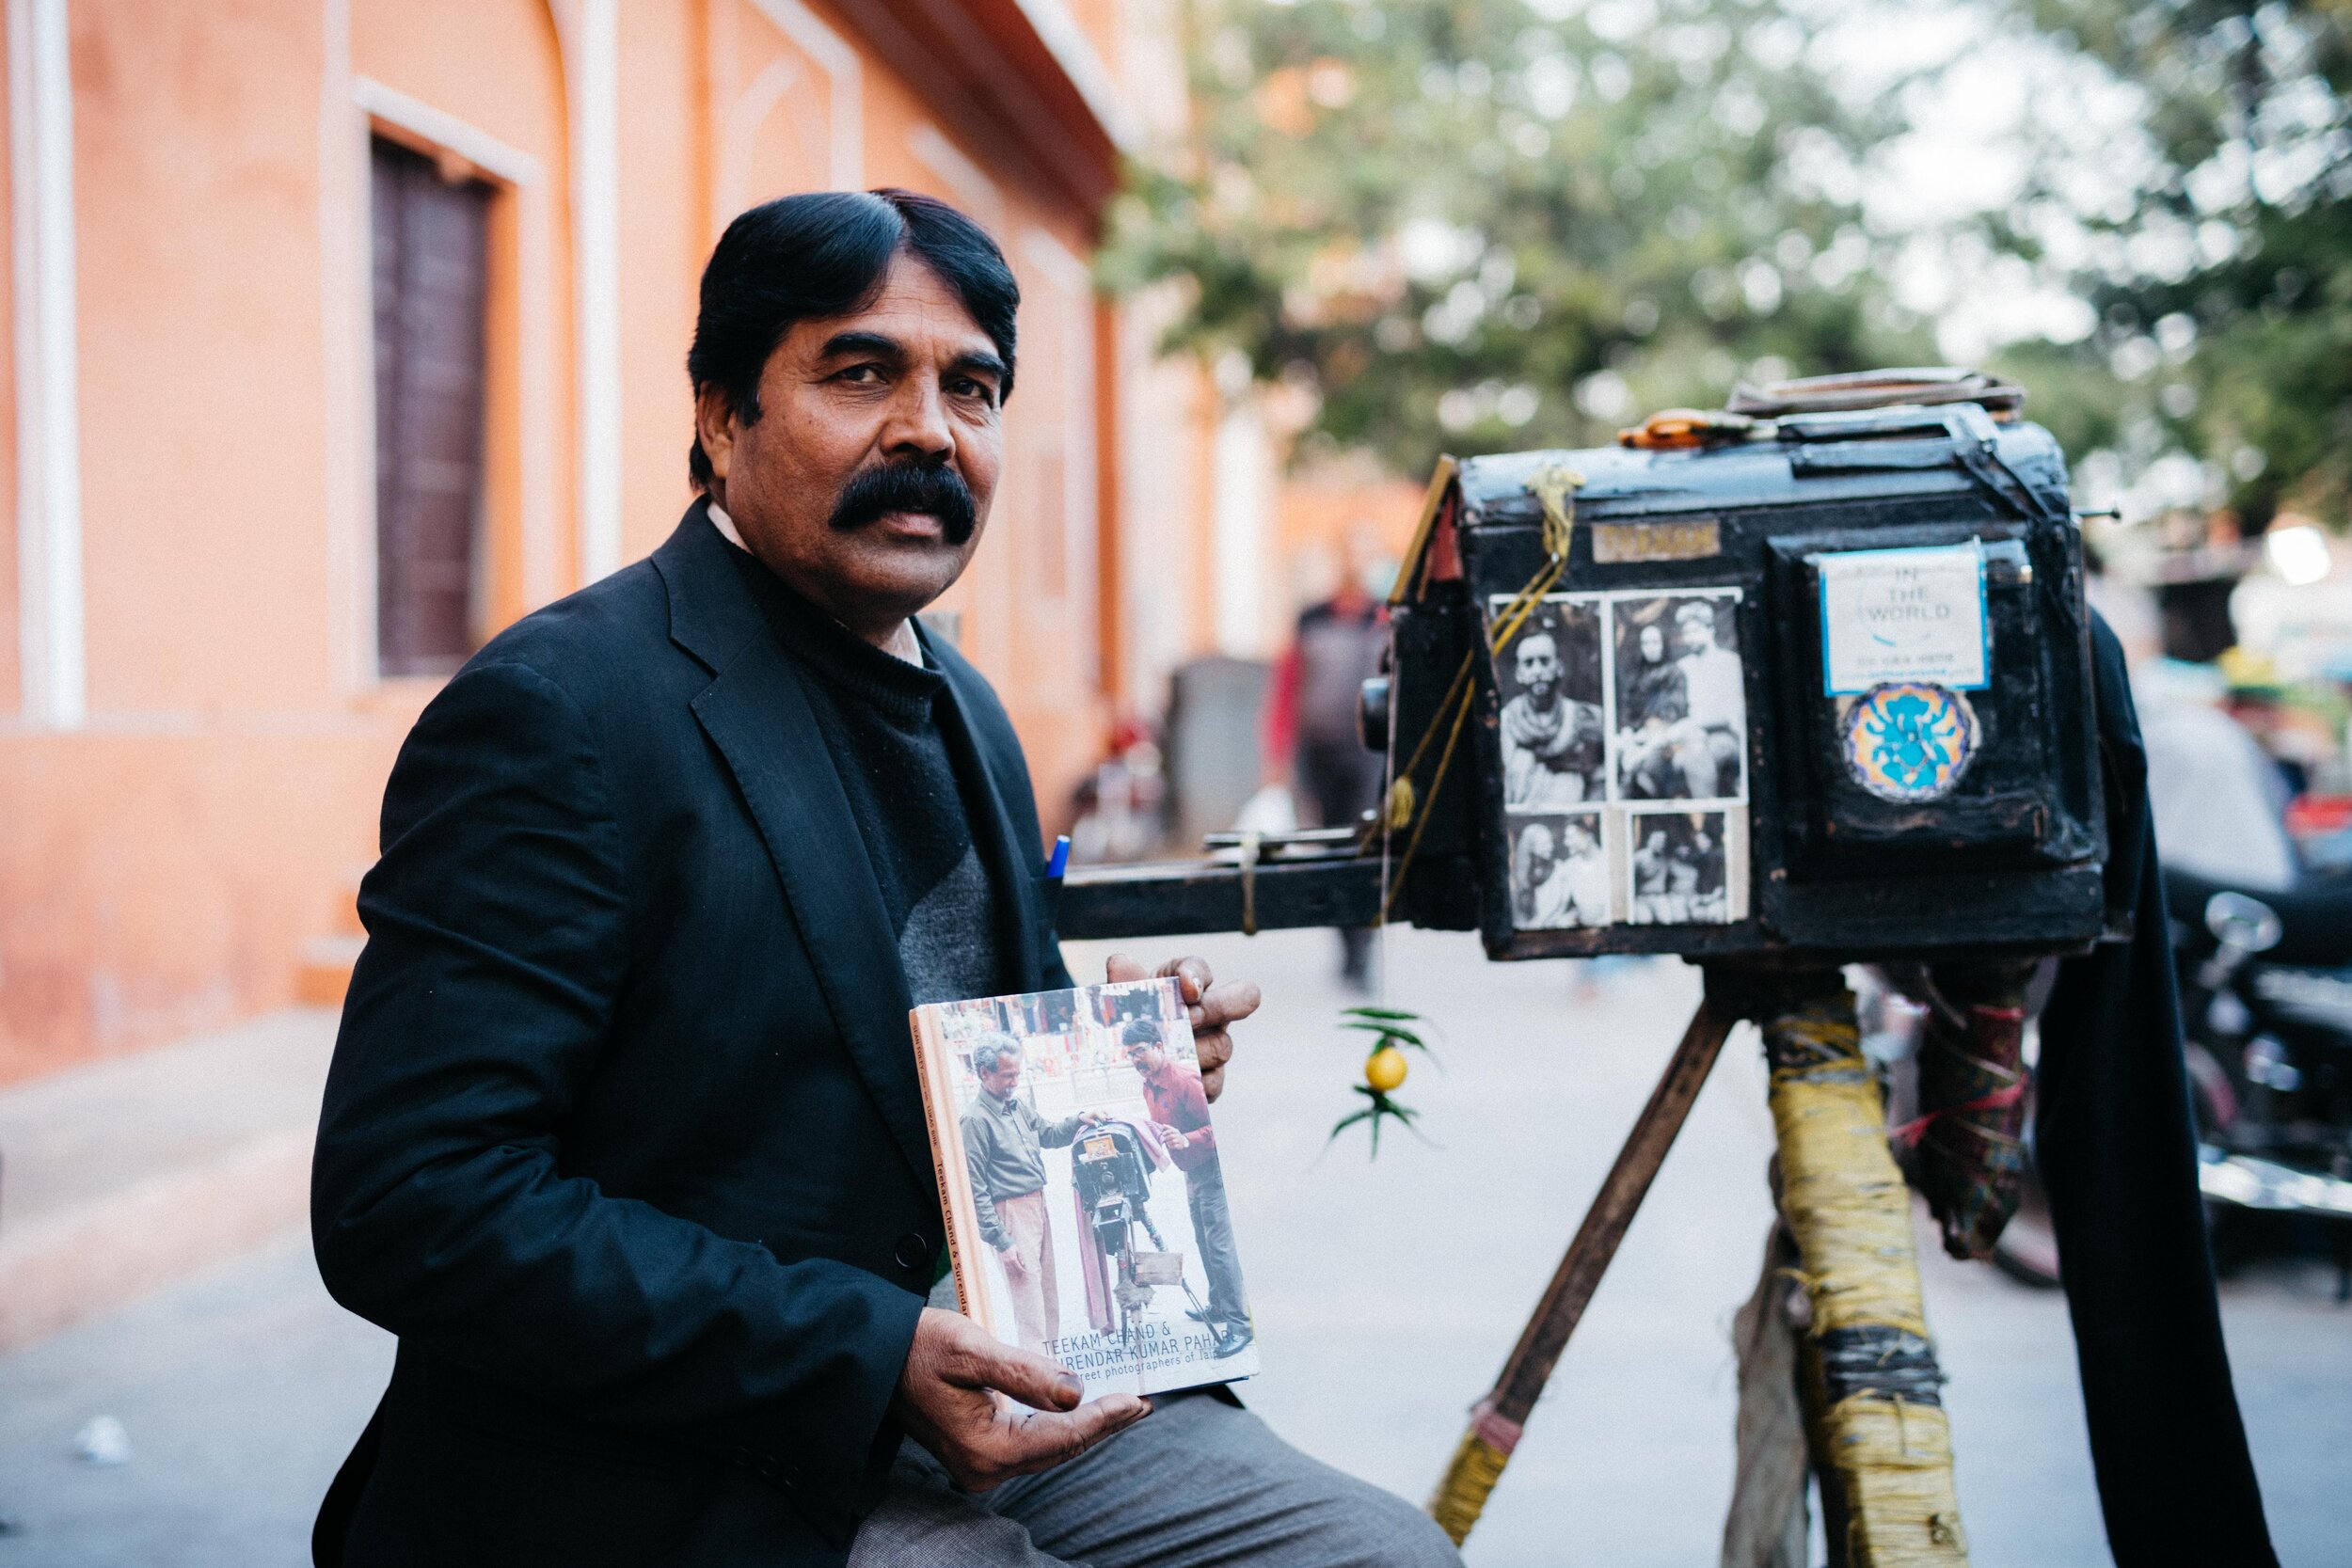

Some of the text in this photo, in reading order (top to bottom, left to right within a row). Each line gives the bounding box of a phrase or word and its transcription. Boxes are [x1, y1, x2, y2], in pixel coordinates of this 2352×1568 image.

[1887, 586, 1928, 602] THE
[1867, 603, 1951, 621] WORLD
[937, 1163, 948, 1205] Teekam
[945, 1210, 957, 1245] Chand
[954, 1263, 967, 1316] Surendar
[1042, 1321, 1171, 1355] TEEKAM CHAND &
[1129, 1338, 1179, 1360] KUMAR
[1104, 1357, 1181, 1380] photographers
[1185, 1352, 1194, 1363] of
